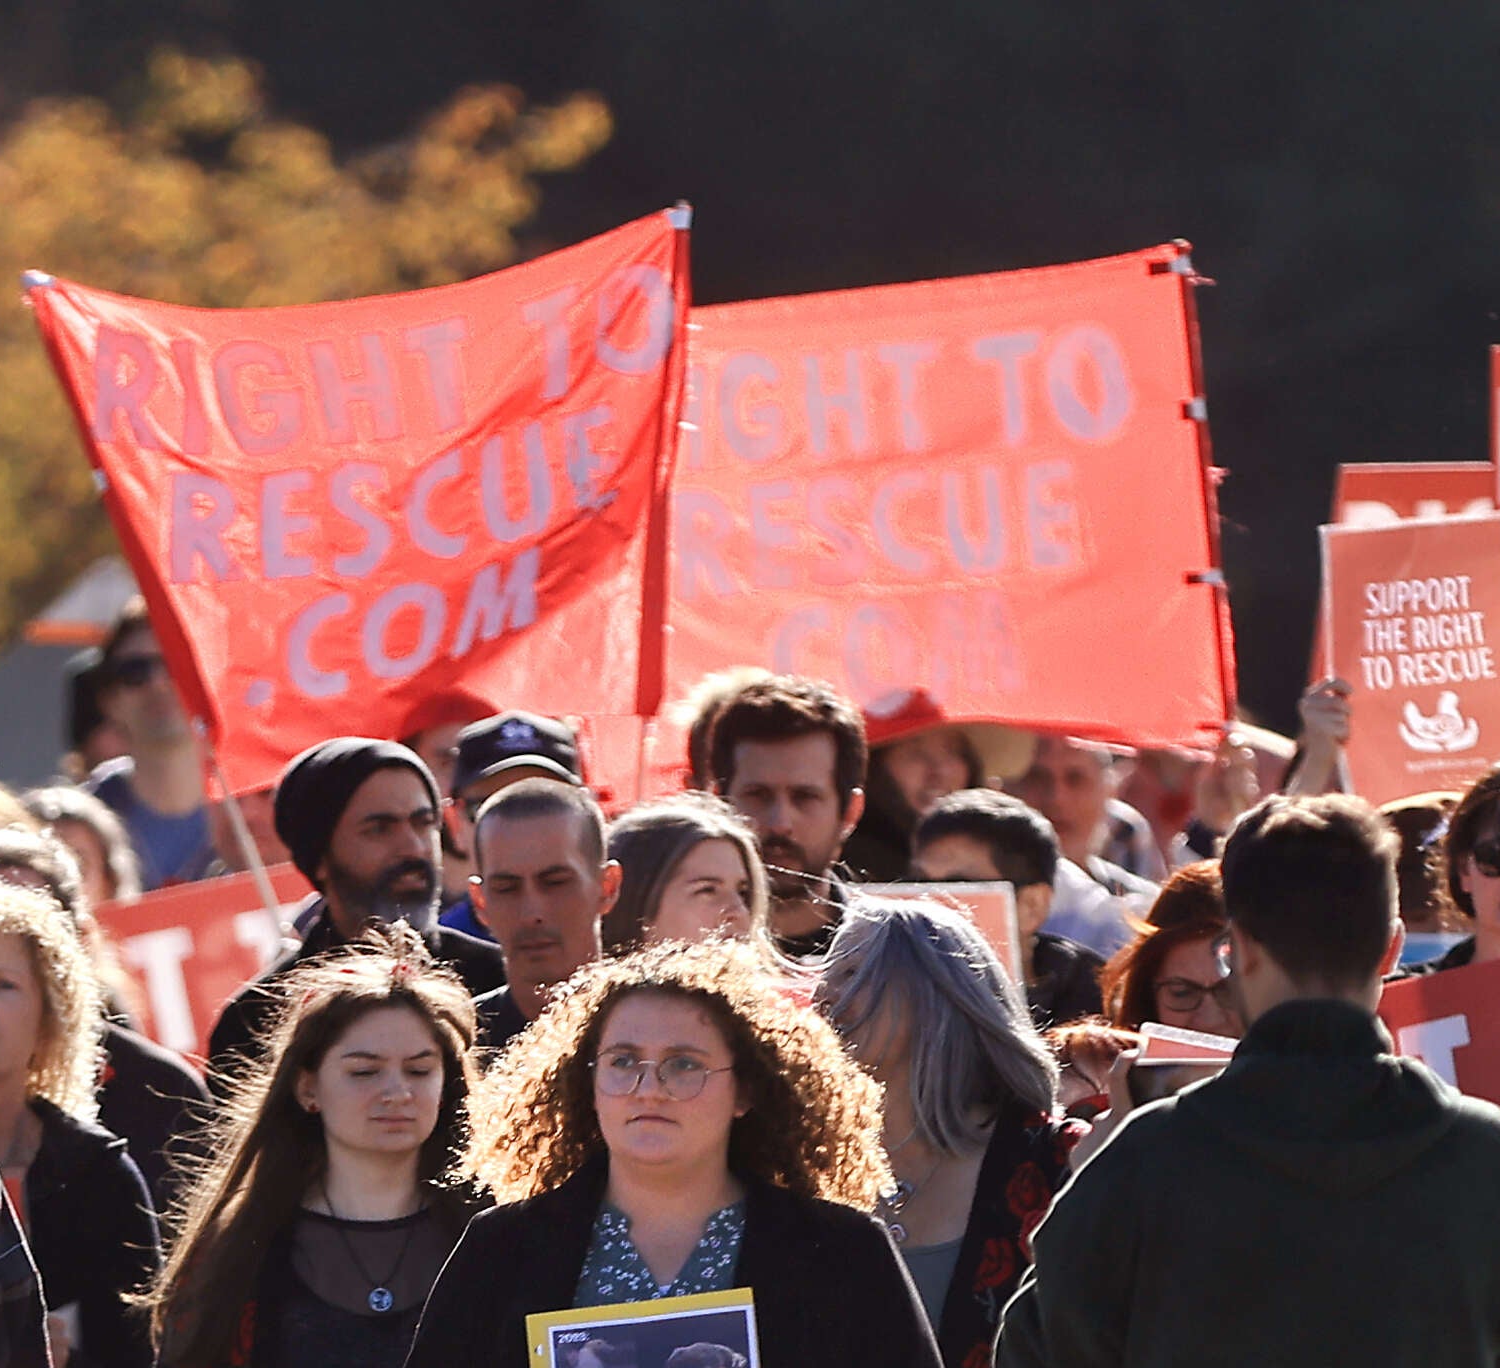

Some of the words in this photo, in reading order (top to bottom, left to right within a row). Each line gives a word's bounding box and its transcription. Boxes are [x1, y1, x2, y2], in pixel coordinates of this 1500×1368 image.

[90, 315, 469, 457] RIGHT
[524, 262, 674, 400] TO
[974, 325, 1135, 447] TO
[170, 403, 621, 583] RESCUE
[674, 458, 1076, 598] RESCUE
[245, 551, 542, 706] .COM
[1361, 618, 1409, 653] THE
[1411, 611, 1485, 649] RIGHT
[1364, 575, 1471, 617] SUPPORT
[1360, 655, 1395, 690] TO
[1398, 646, 1498, 688] RESCUE
